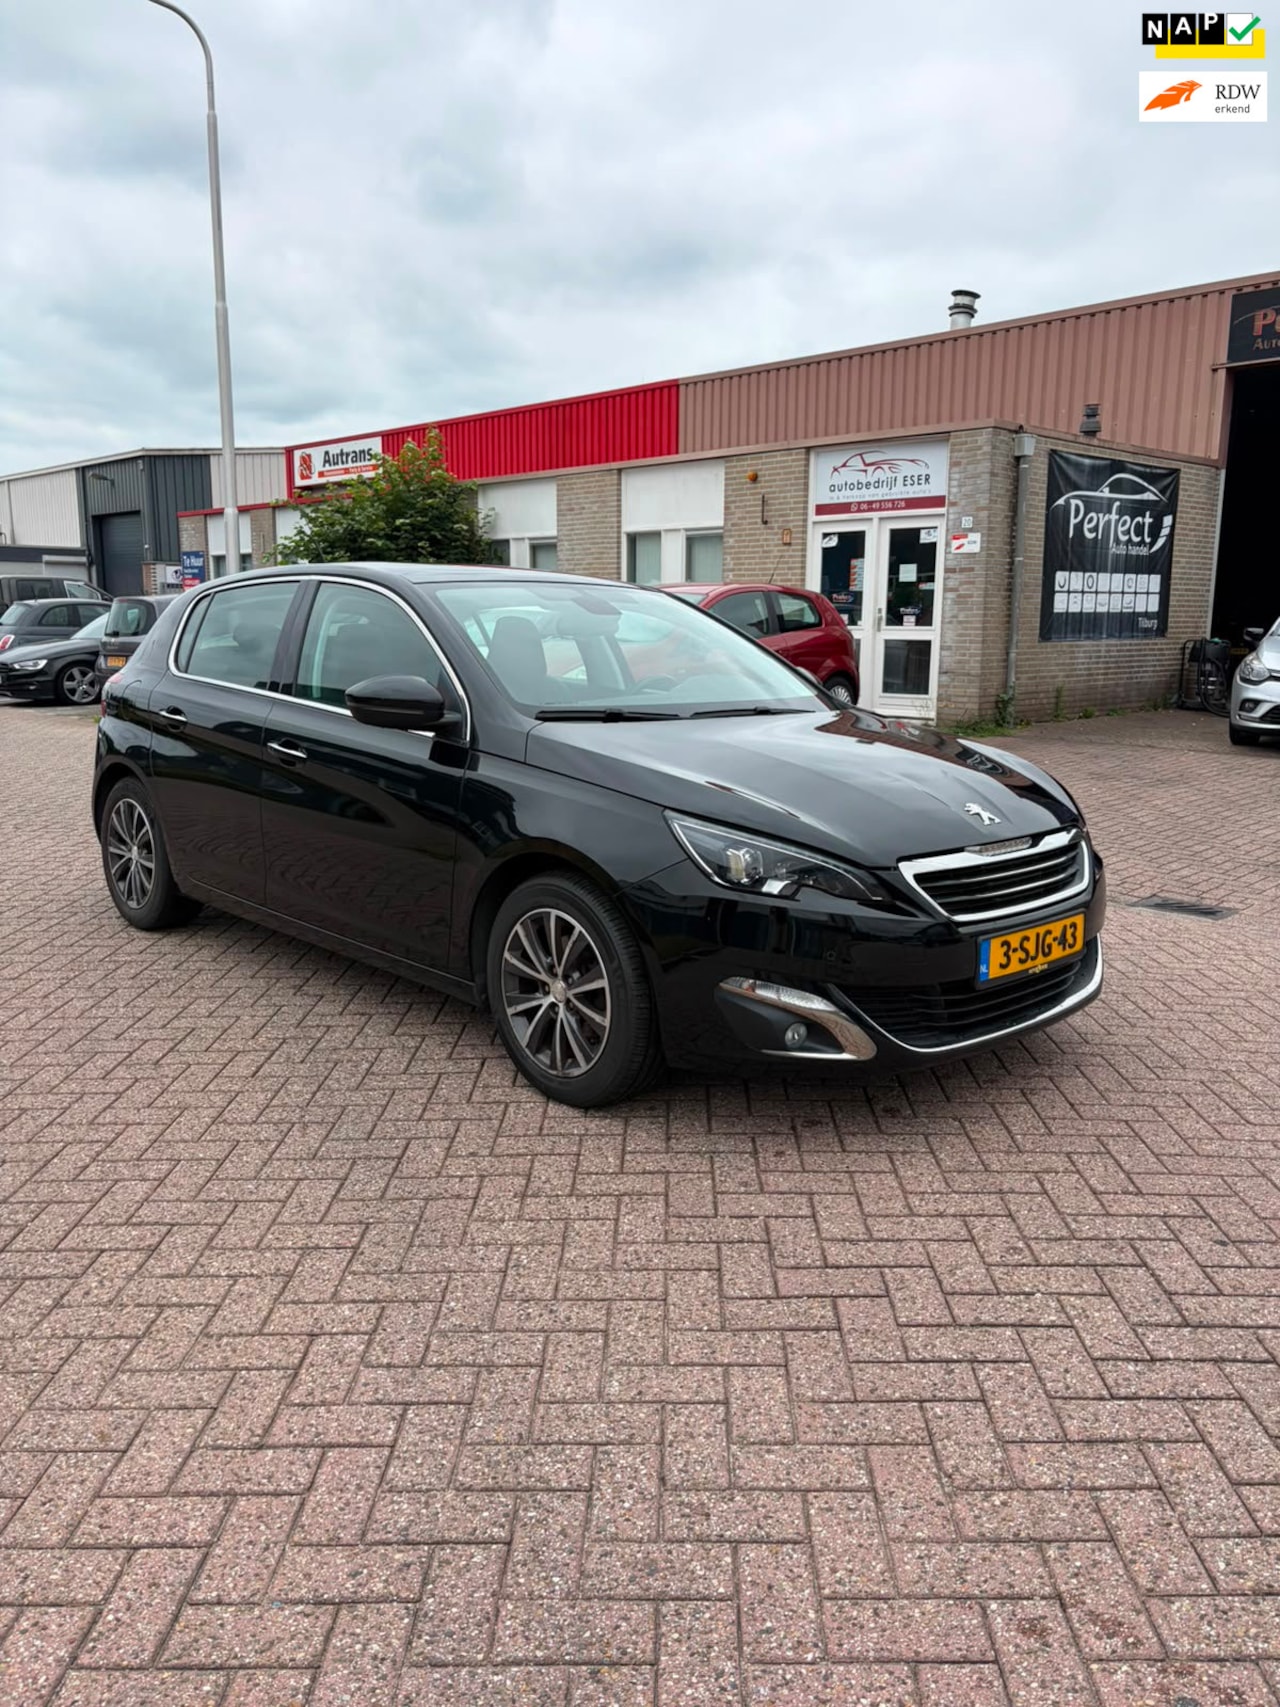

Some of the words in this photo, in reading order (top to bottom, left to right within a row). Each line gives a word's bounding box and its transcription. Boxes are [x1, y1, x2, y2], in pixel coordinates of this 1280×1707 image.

[322, 447, 373, 468] Autrans
[829, 475, 898, 493] autobedrijf
[903, 473, 931, 487] ESER
[963, 518, 971, 526] 20
[1069, 499, 1153, 549] Perfect
[1128, 543, 1149, 556] handel
[190, 555, 203, 567] Huur
[1138, 617, 1158, 630] Tilburg
[999, 921, 1077, 970] 3-SJG-43
[980, 964, 989, 974] NL
